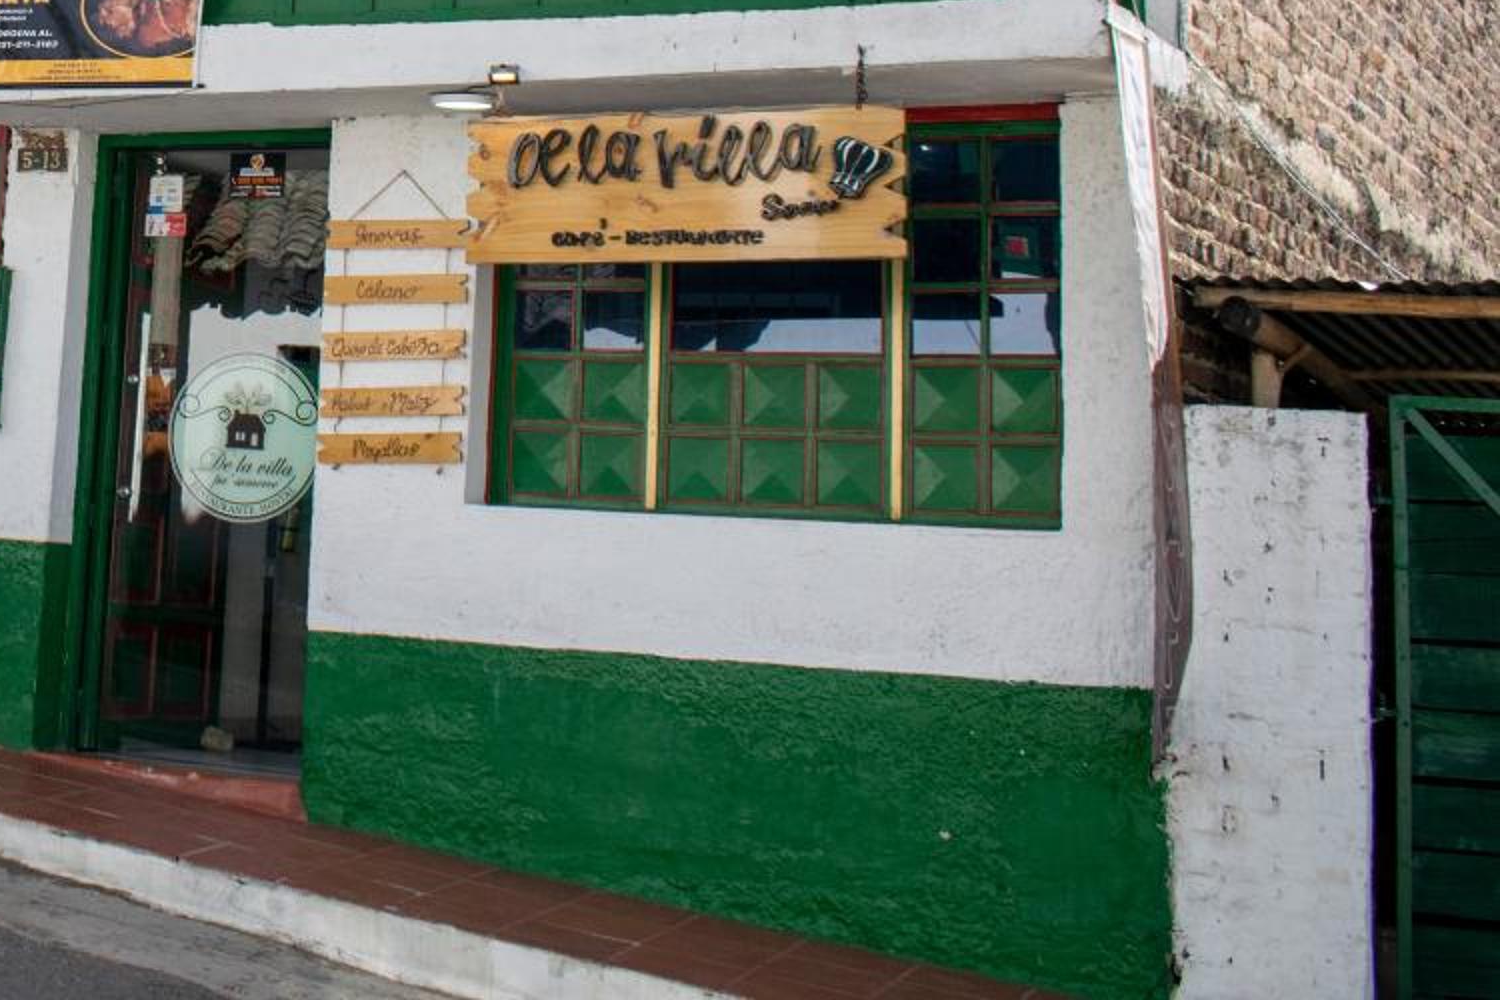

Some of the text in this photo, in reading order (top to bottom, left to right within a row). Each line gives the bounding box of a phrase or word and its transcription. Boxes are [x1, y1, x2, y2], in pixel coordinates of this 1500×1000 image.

[22, 150, 61, 170] 5-13
[235, 455, 253, 473] la
[257, 457, 294, 477] villa
